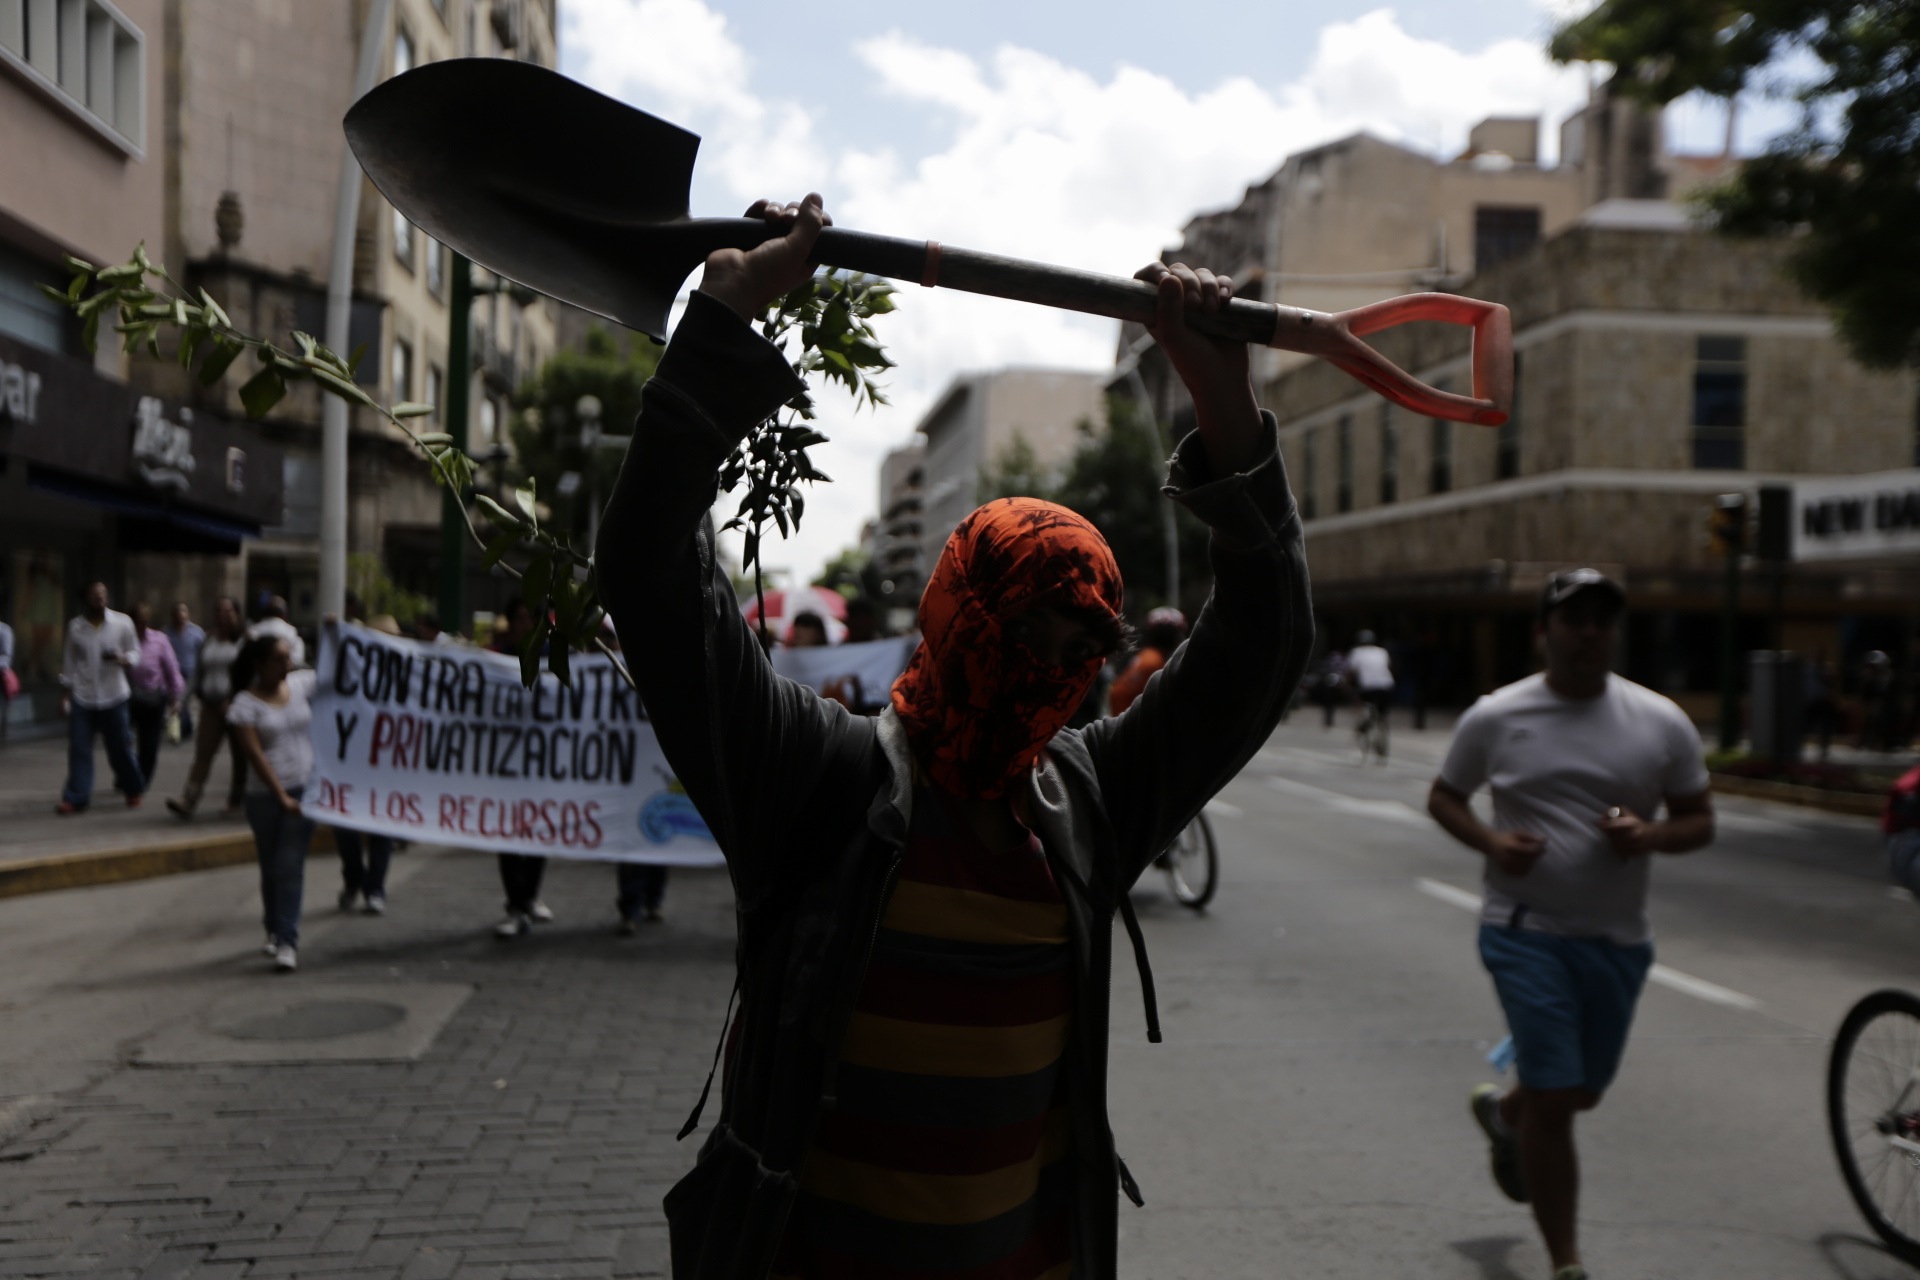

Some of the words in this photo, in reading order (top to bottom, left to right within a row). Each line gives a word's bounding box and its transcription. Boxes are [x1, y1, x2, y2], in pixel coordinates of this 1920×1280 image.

[335, 636, 486, 715] CONTRA
[491, 679, 523, 719] LA
[336, 711, 359, 761] Y
[369, 713, 636, 785] PRIVATIZACIÓN
[318, 777, 353, 816] DE
[369, 787, 425, 826] LOS
[438, 795, 604, 849] RECURSOS
